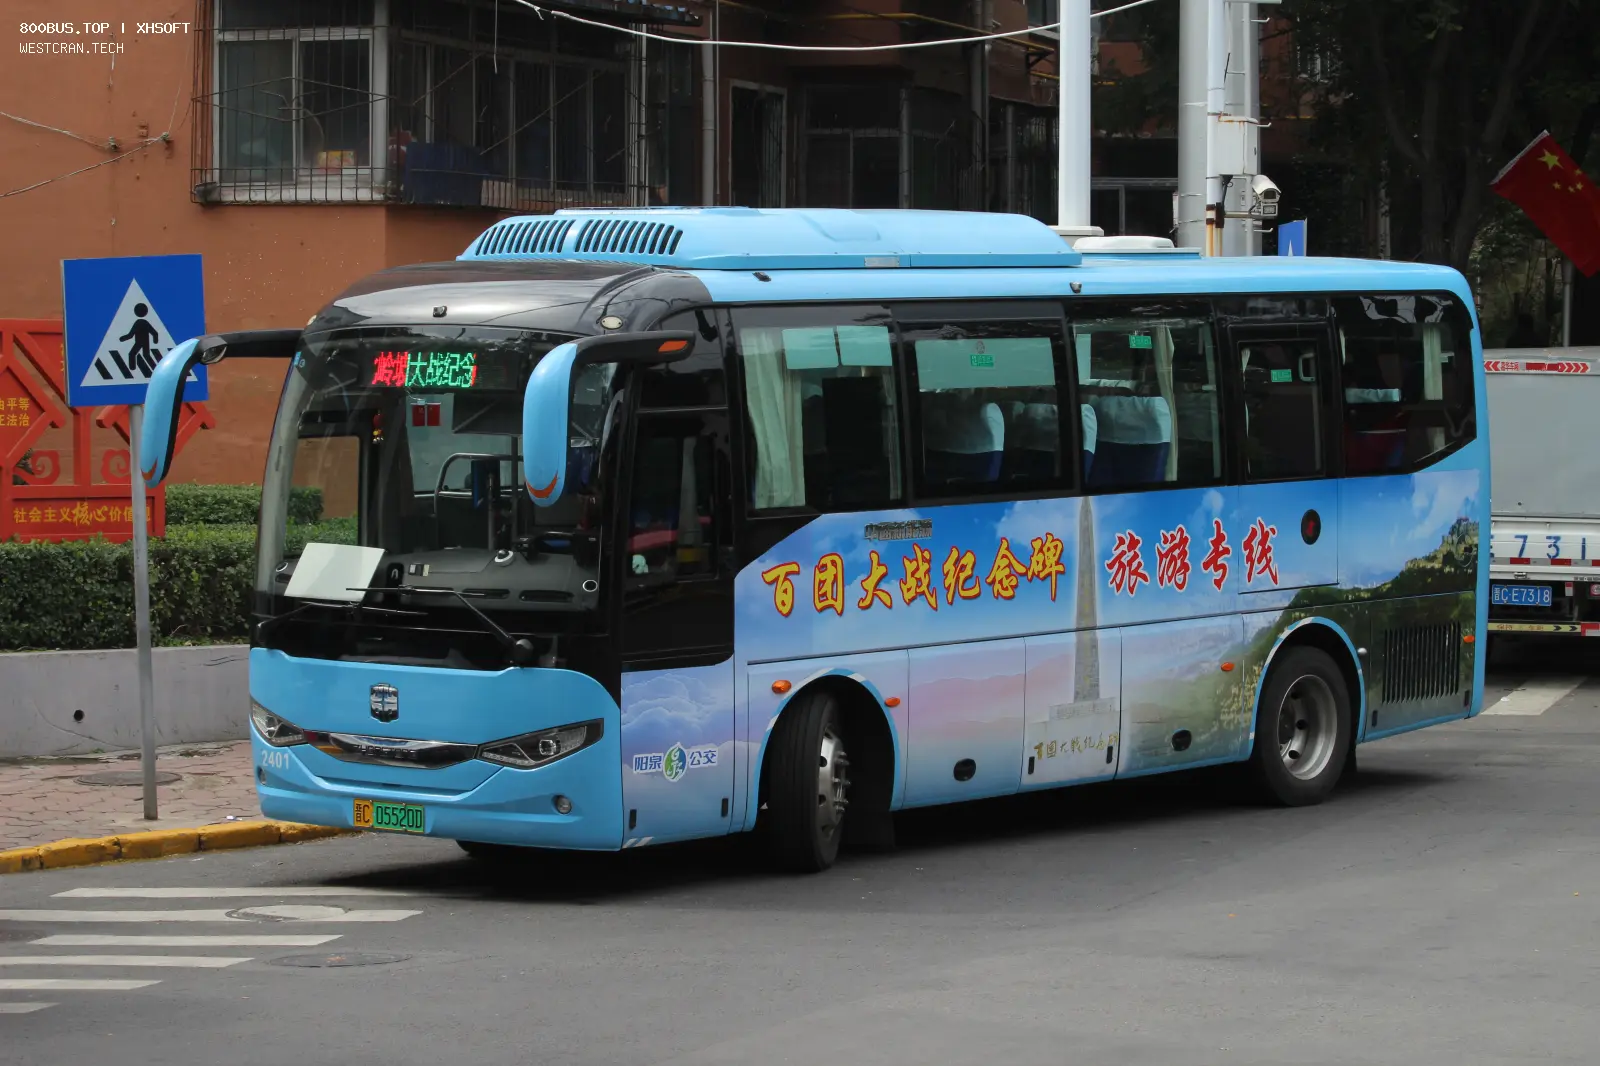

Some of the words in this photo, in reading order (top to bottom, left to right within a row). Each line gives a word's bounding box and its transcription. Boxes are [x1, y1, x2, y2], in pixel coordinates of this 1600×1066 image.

[761, 532, 1066, 617] 百团大战纪念碑
[1105, 517, 1280, 597] 旅游专线
[261, 750, 289, 770] 2401
[634, 754, 663, 772] 阳泉
[689, 749, 717, 767] 公交
